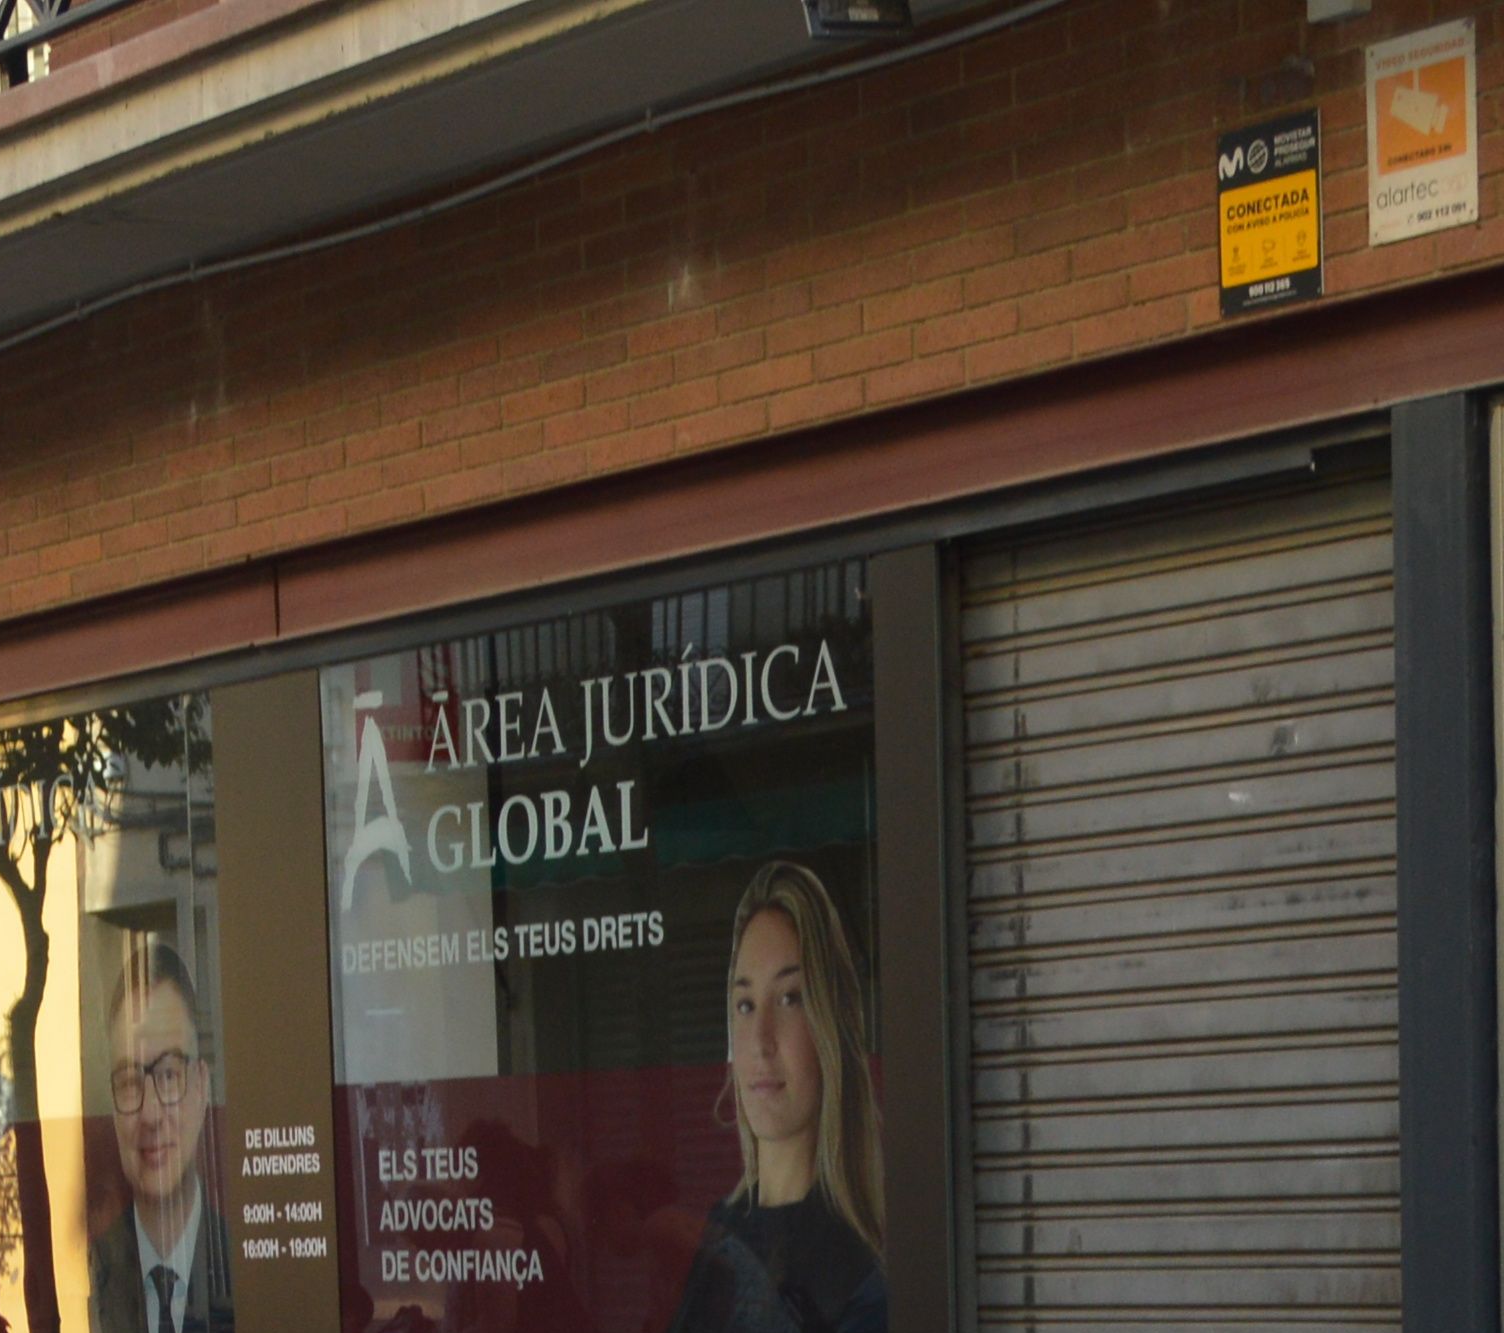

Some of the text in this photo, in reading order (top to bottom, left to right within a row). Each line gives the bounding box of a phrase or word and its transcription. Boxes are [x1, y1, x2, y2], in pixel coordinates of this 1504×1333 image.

[1226, 187, 1310, 221] CONECTADA
[1376, 178, 1439, 210] alartec
[1226, 219, 1245, 235] CON
[1246, 215, 1270, 232] AVISO
[580, 638, 848, 769] JURÍDICA
[426, 780, 649, 873] GLOBAL
[342, 910, 665, 975] DEFENSEM ELS TEUS DRETS
[245, 1125, 316, 1149] DE DILLUNS
[242, 1152, 321, 1177] A DIVENDRES
[378, 1146, 479, 1182] ELS TEUS
[243, 1201, 322, 1224] 9:00H 14:00H
[379, 1197, 494, 1233] ADVOCATS
[242, 1236, 327, 1260] 16:00H 19:00H
[381, 1248, 544, 1290] DE CONFIANÇA
